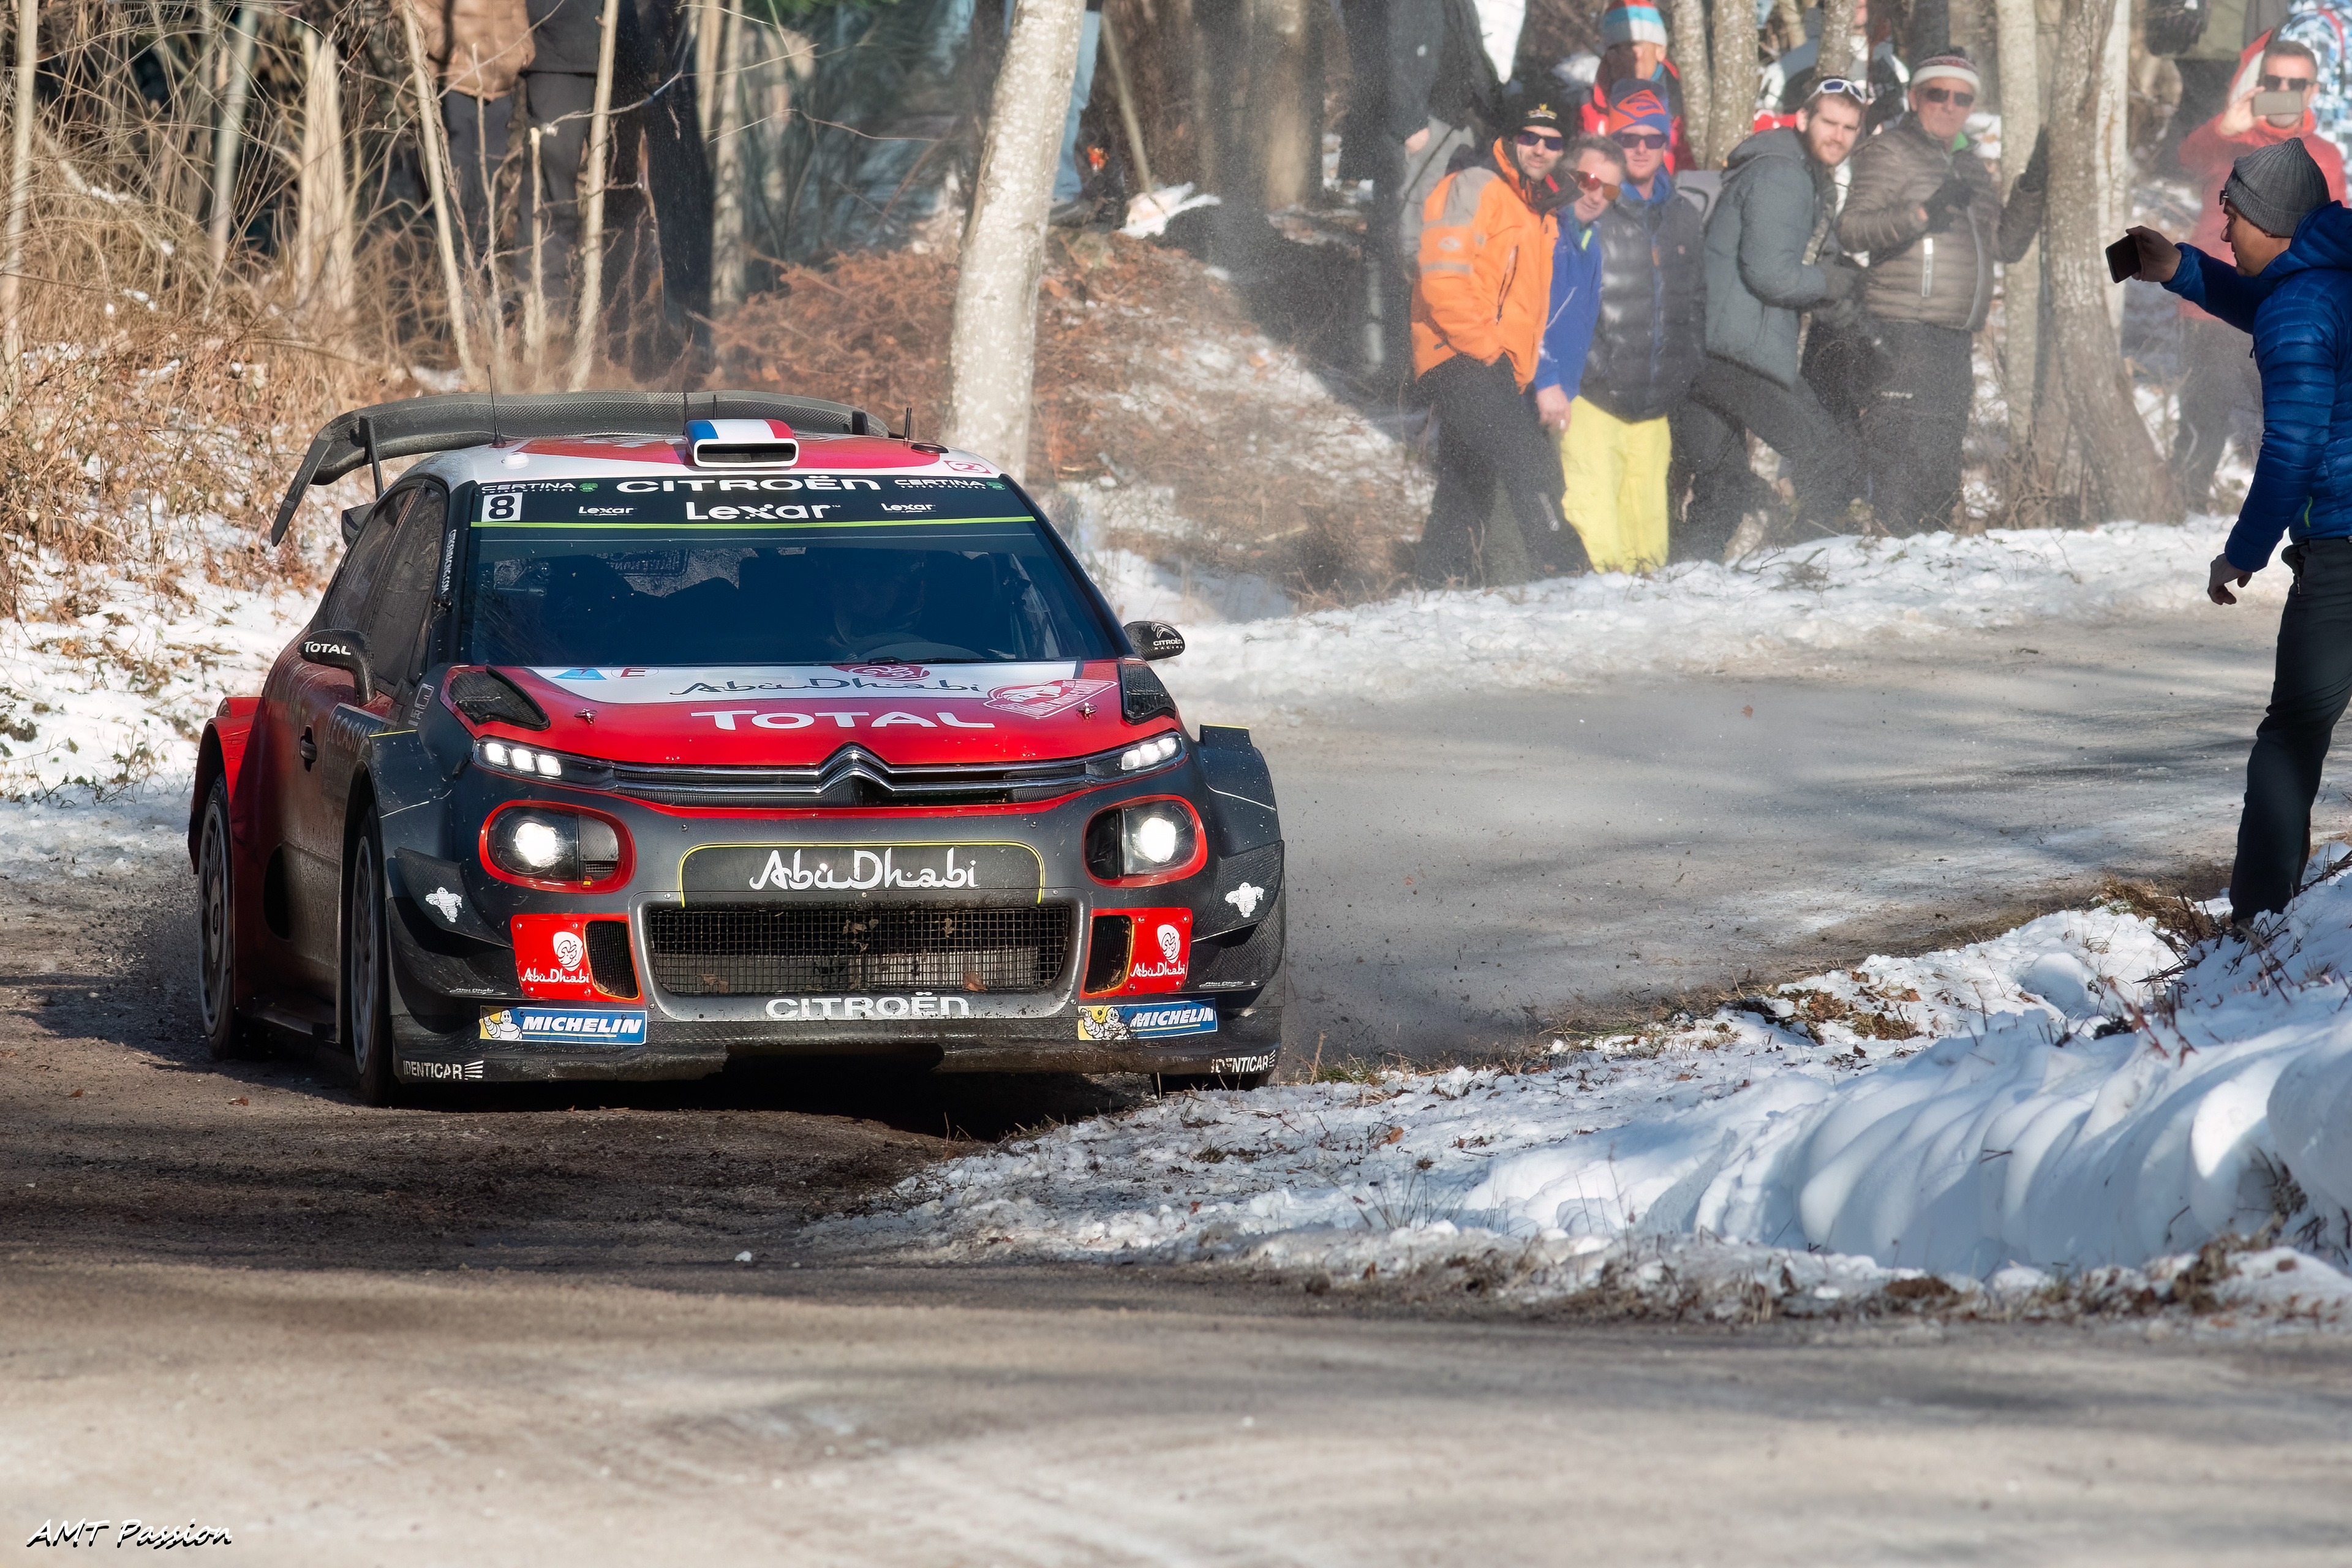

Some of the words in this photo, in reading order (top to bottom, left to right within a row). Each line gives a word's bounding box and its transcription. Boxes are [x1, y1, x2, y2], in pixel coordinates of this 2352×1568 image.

[488, 496, 515, 519] 8
[304, 641, 352, 655] TOTAL
[690, 710, 995, 731] TOTAL
[522, 1016, 643, 1034] MICHELIN
[1130, 1007, 1213, 1028] MICHELIN
[403, 1060, 462, 1080] IDENTICAR
[1210, 1055, 1268, 1074] IDENTICAR
